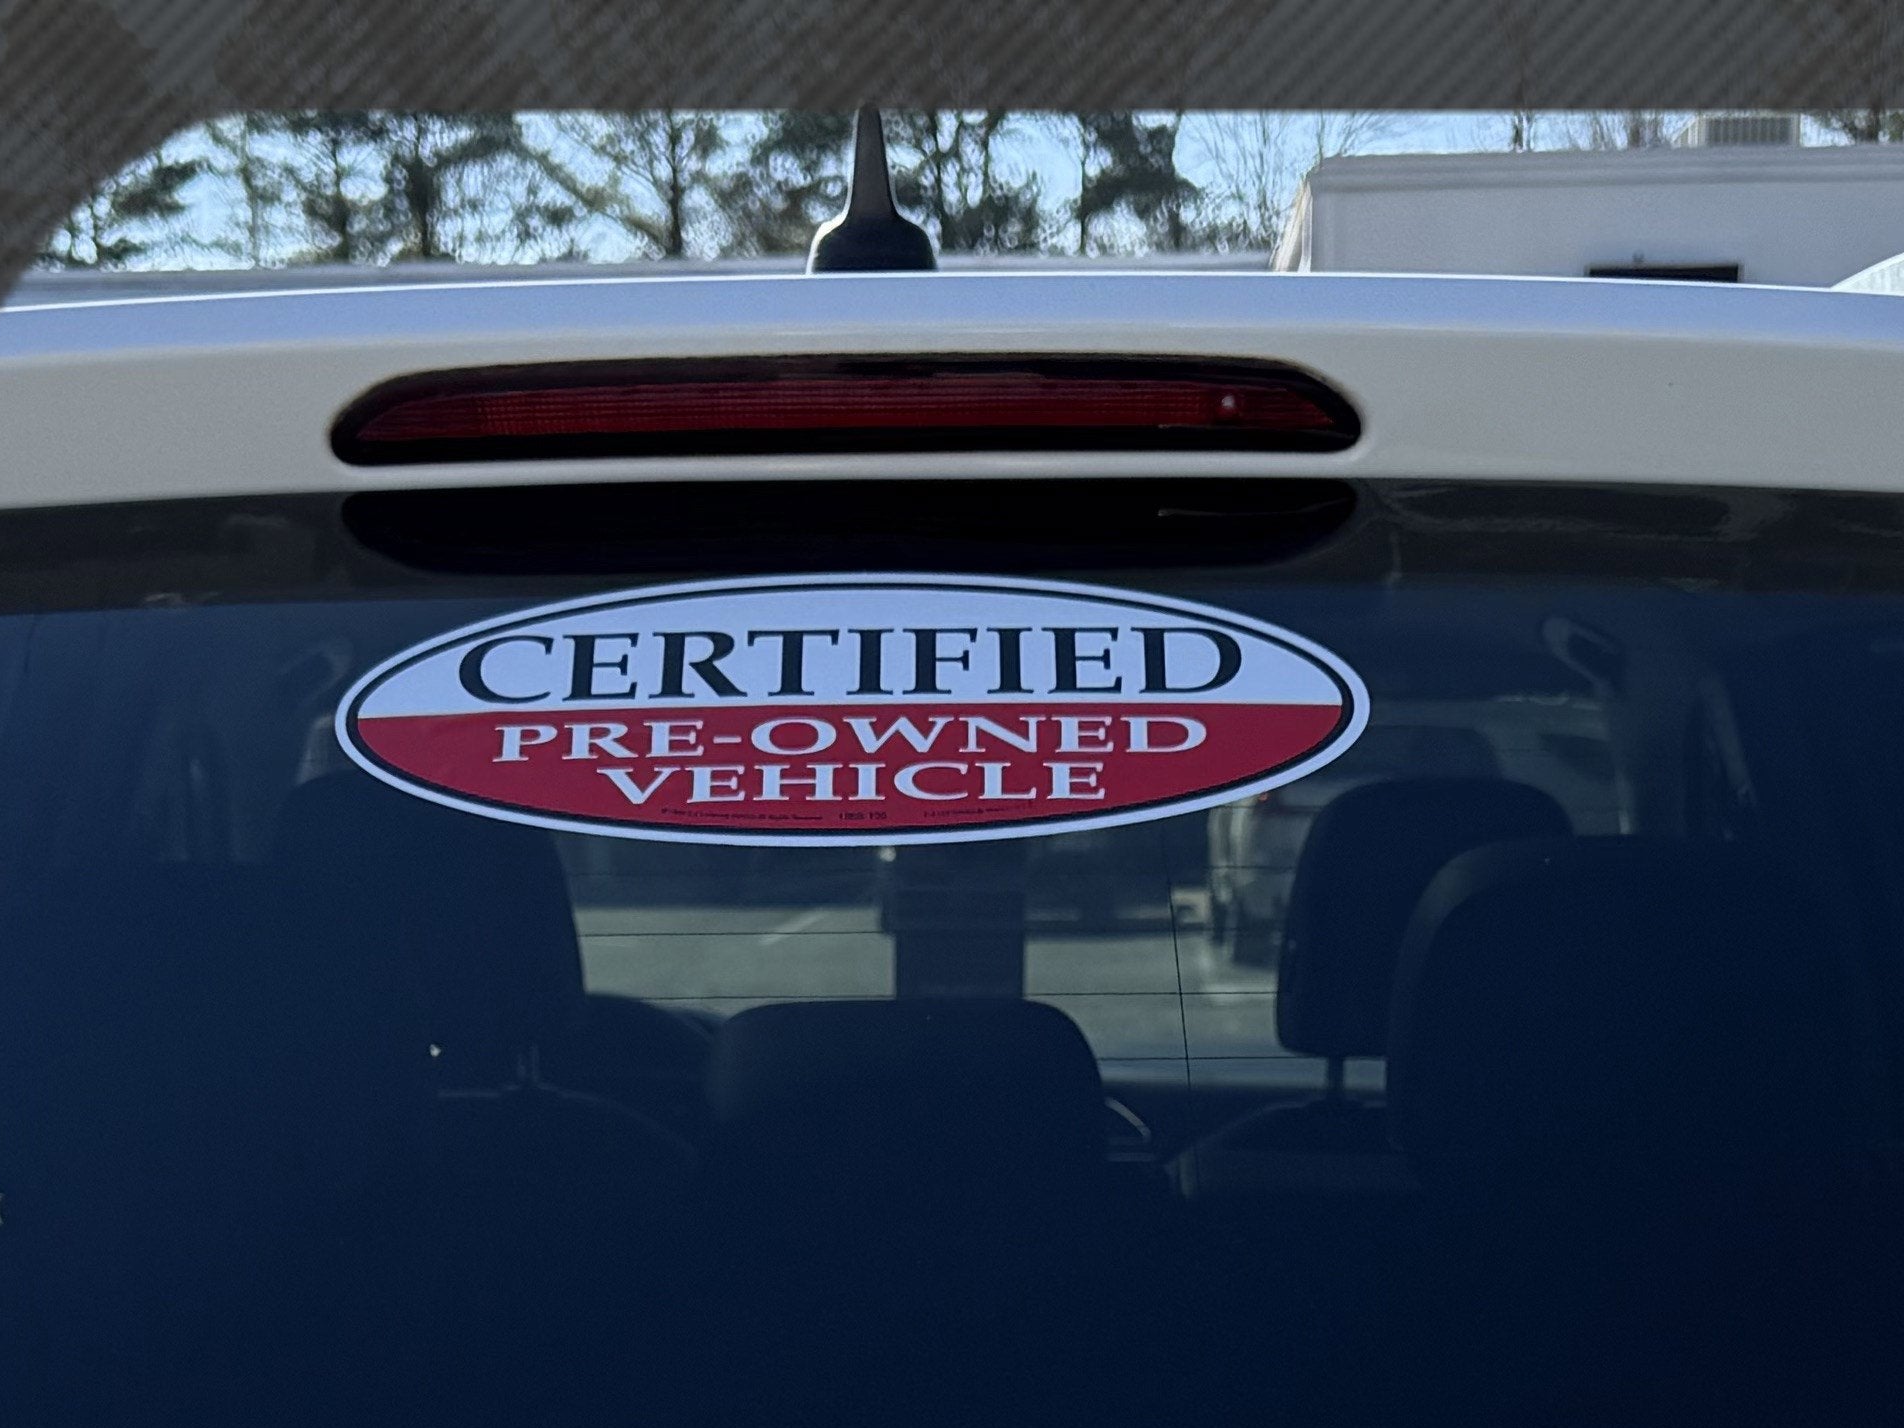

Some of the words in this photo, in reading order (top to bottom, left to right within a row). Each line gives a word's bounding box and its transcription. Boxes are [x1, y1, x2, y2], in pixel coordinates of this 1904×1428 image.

[456, 625, 1245, 705] CERTIFIED
[492, 714, 1209, 764] PRE-OWNED
[595, 758, 1108, 806] VEHICLE
